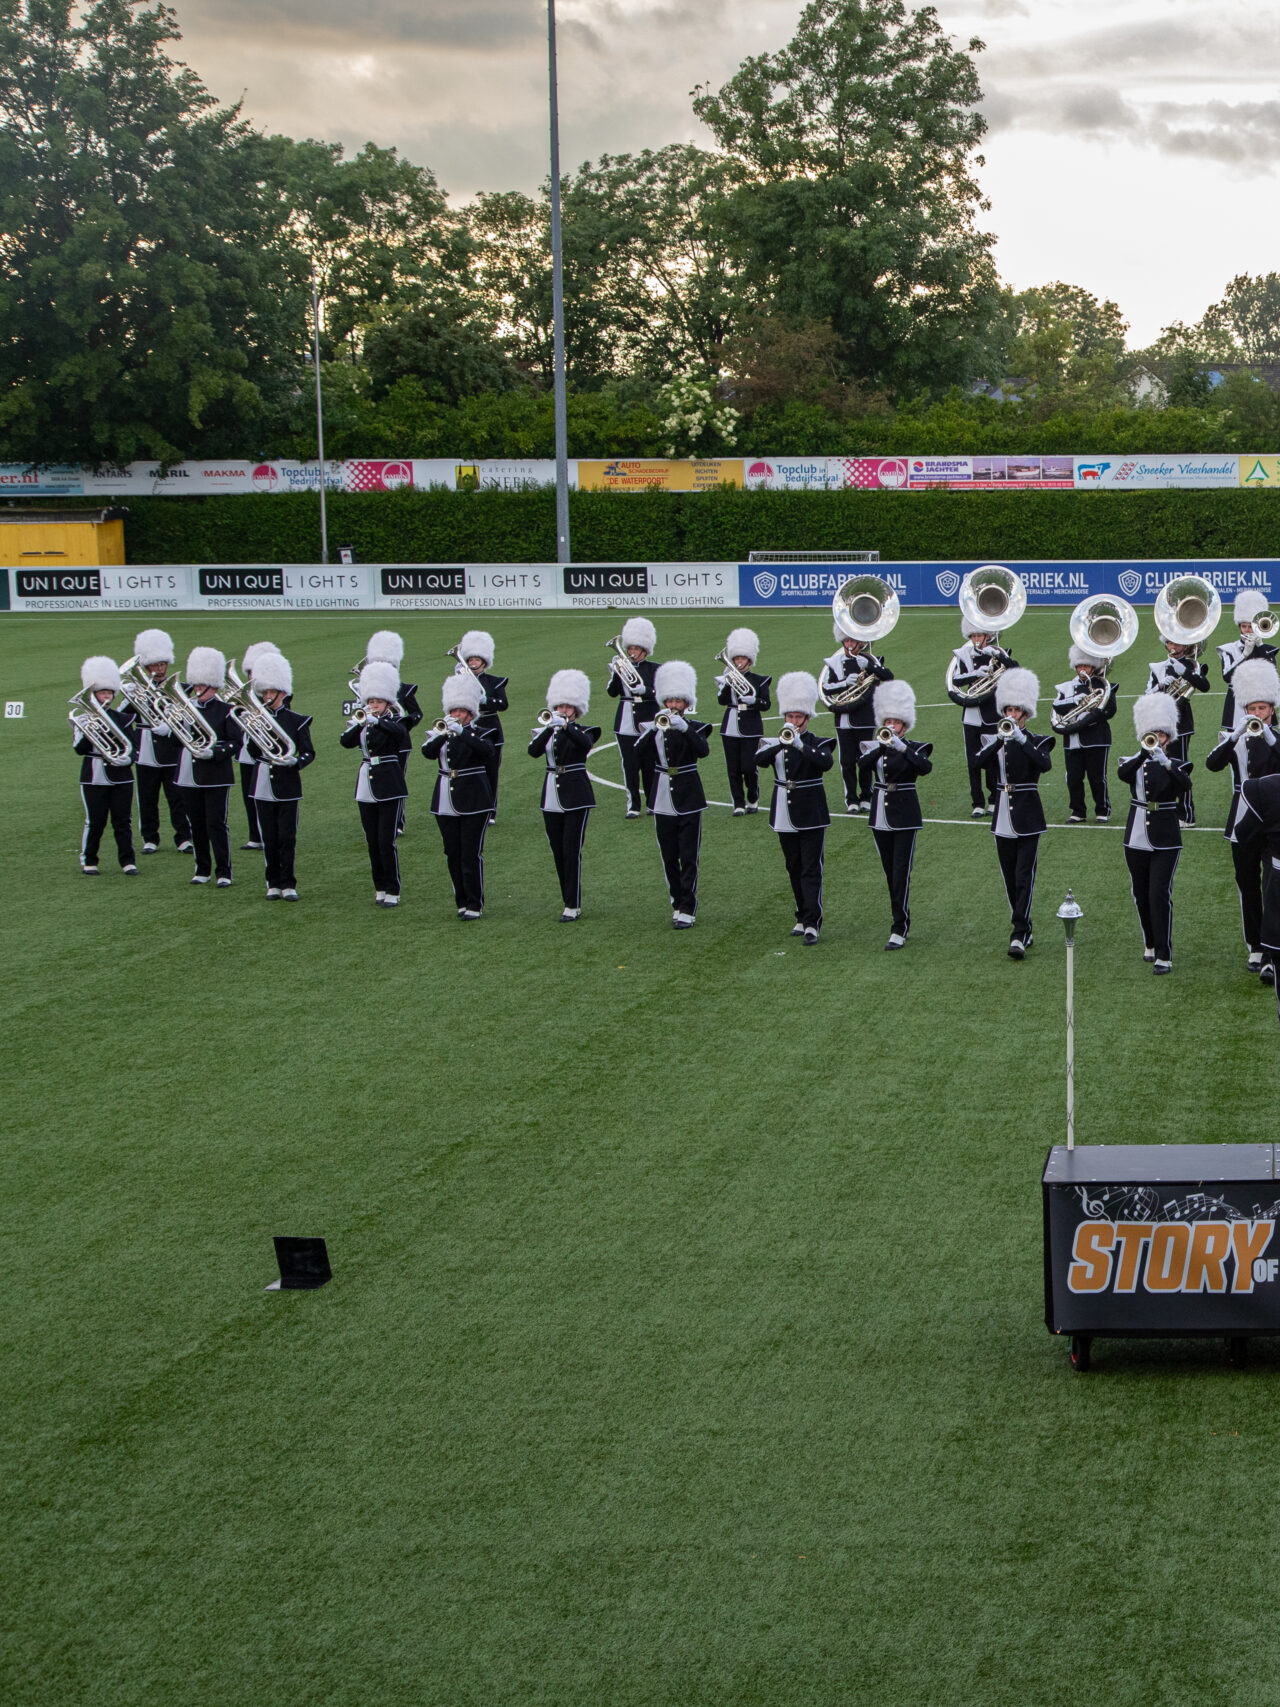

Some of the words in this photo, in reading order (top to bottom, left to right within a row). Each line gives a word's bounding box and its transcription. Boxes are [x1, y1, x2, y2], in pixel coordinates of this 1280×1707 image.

[281, 467, 321, 479] Topclub
[481, 466, 533, 474] catering
[776, 464, 817, 476] Topclub
[1136, 462, 1174, 475] Sneeker
[1178, 462, 1235, 475] Vleeshandel
[786, 474, 839, 484] bedrijfsafval
[23, 576, 99, 590] UNIQUE
[104, 576, 176, 589] LIGHTS
[206, 575, 281, 589] UNIQUE
[286, 575, 358, 588] LIGHTS
[388, 575, 463, 588] UNIQUE
[469, 575, 541, 588] LIGHTS
[571, 574, 645, 588] UNIQUE
[651, 573, 723, 587] LIGHTS
[1145, 571, 1271, 587] CLUBRIEK.NL
[25, 600, 99, 609] PROFESSIONALS
[102, 600, 112, 608] IN
[114, 600, 131, 608] LED
[134, 599, 178, 608] LIGHTING
[208, 599, 281, 607] PROFESSIONALS
[284, 599, 293, 607] IN
[296, 599, 313, 607] LED
[316, 598, 360, 607] LIGHTING
[390, 598, 464, 607] PROFESSIONALS
[466, 598, 476, 606] IN
[479, 598, 495, 606] LED
[498, 598, 542, 606] LIGHTING
[572, 597, 646, 605] PROFESSIONALS
[648, 597, 658, 605] IN
[661, 597, 677, 605] LED
[680, 597, 724, 605] LIGHTING
[7, 704, 21, 715] 30
[1068, 1218, 1275, 1294] STORY
[1253, 1259, 1279, 1283] OF
